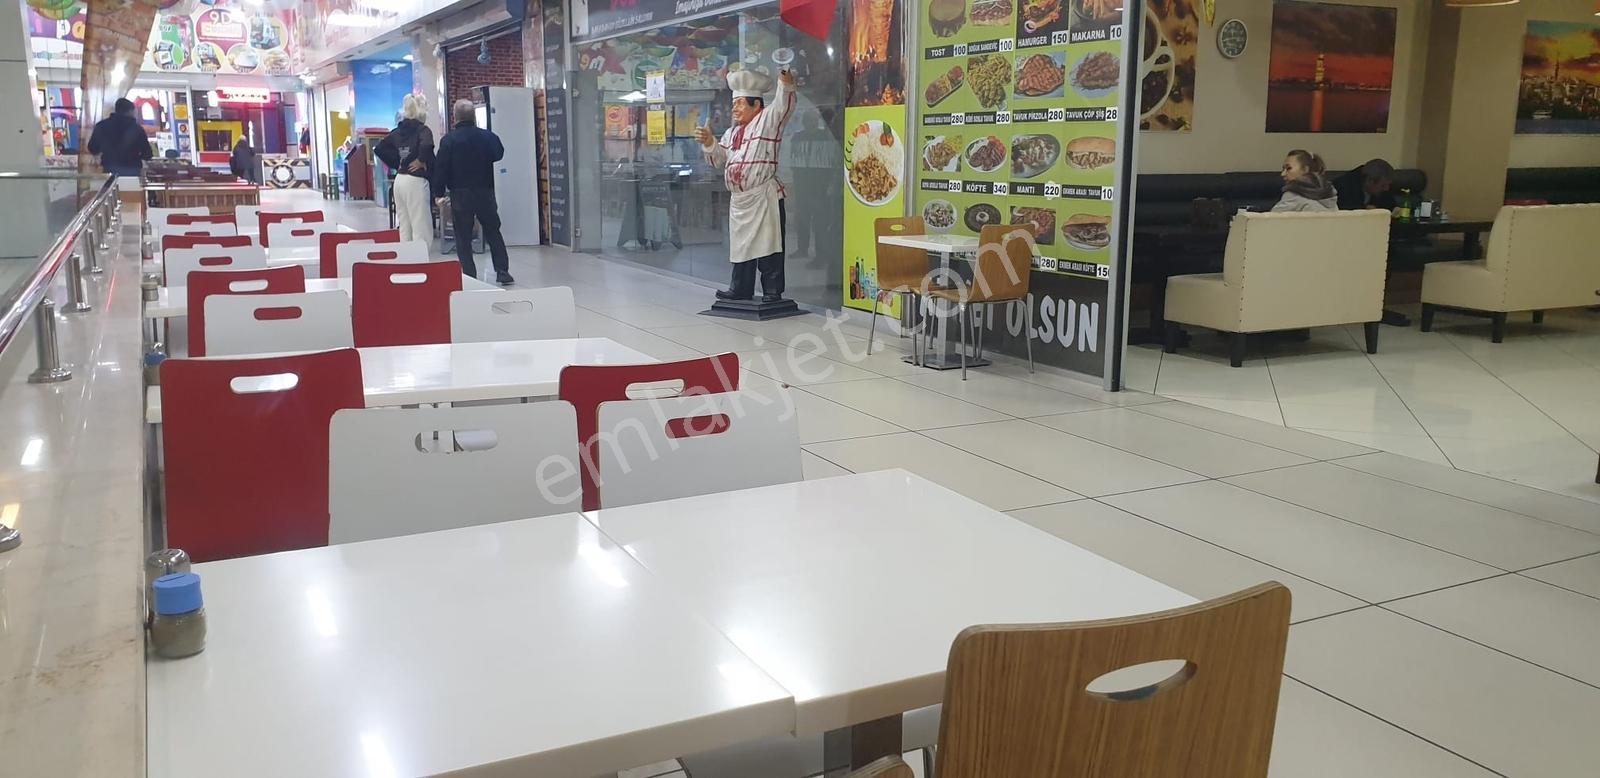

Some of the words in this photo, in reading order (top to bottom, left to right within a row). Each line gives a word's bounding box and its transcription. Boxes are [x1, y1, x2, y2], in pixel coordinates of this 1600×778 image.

[1052, 32, 1067, 44] 150
[1072, 29, 1106, 42] MAKARNA
[931, 48, 945, 57] TOST
[954, 45, 966, 55] 100
[1000, 40, 1013, 51] 100
[951, 114, 964, 124] 280
[996, 113, 1010, 123] 280
[1013, 111, 1029, 121] TAVUK
[1048, 110, 1063, 120] 280
[1066, 110, 1082, 120] TAVUK
[949, 182, 961, 191] 280
[966, 183, 987, 193] KÖFTE
[993, 184, 1007, 194] 340
[1017, 185, 1035, 194] MANTI
[1045, 185, 1059, 196] 220
[1041, 258, 1056, 269] 280
[1005, 292, 1099, 353] OLSUN
